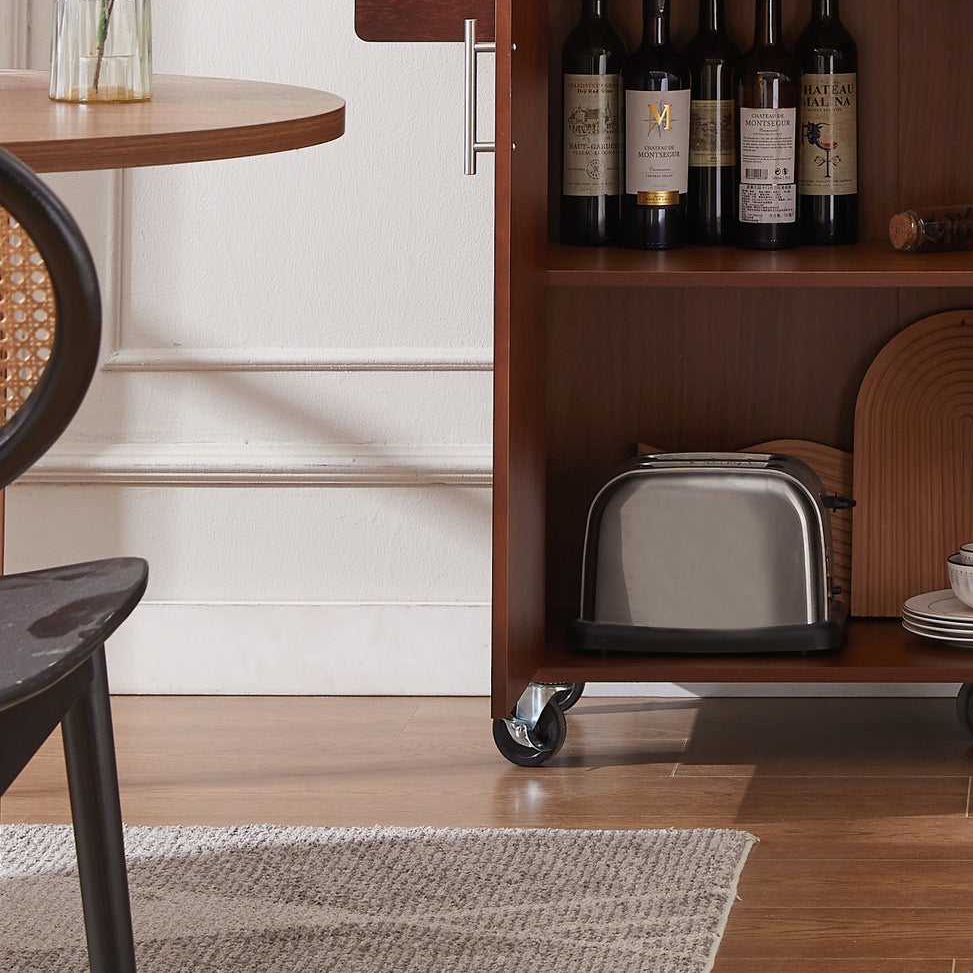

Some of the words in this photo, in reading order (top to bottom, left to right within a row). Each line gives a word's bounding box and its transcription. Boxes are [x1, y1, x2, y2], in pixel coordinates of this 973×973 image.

[803, 83, 854, 95] HATEAU
[647, 103, 673, 132] M
[745, 119, 791, 127] MONTSEGUR
